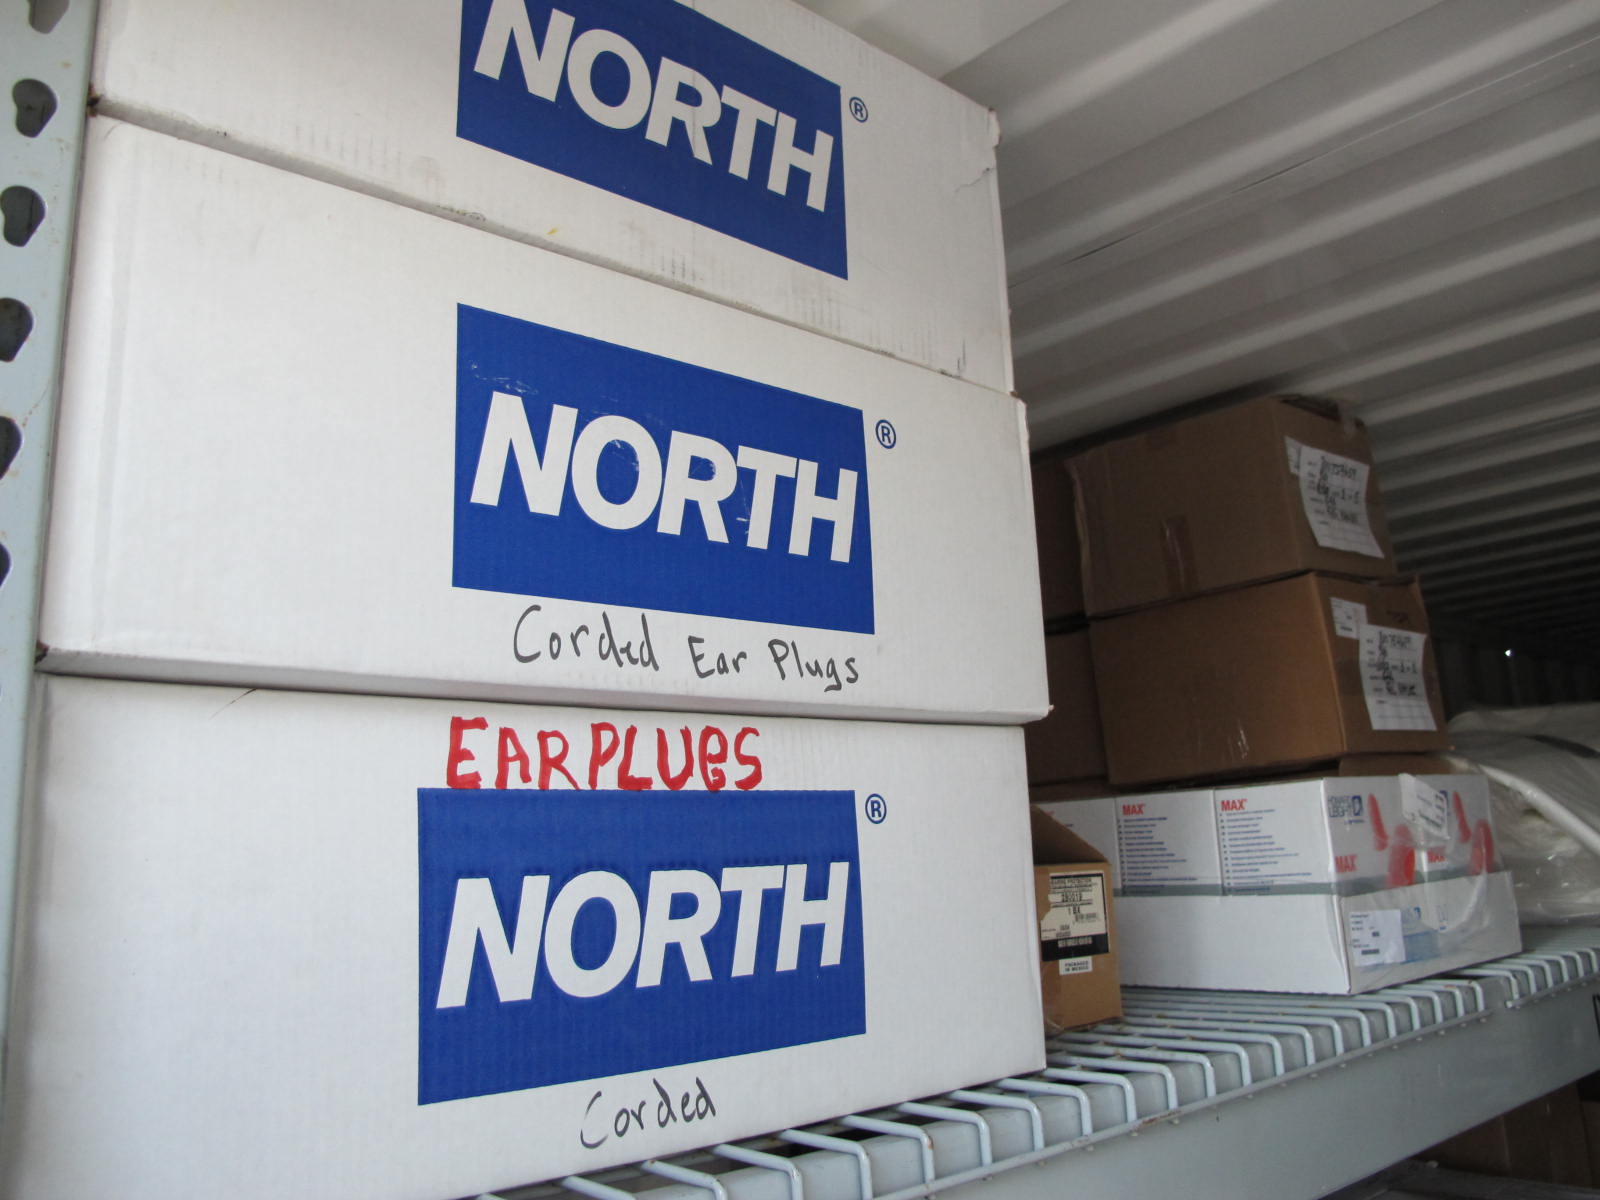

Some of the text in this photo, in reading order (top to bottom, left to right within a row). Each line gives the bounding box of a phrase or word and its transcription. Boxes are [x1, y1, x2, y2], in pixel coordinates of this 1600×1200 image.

[473, 0, 834, 213] NORTH
[469, 390, 859, 563] NORTH
[512, 604, 860, 693] Corded Ear Plugs
[1122, 803, 1145, 816] MAX
[1221, 799, 1246, 812] MAX
[1335, 854, 1358, 873] MAX
[435, 861, 850, 1010] NORTH
[579, 1077, 717, 1149] Corded
